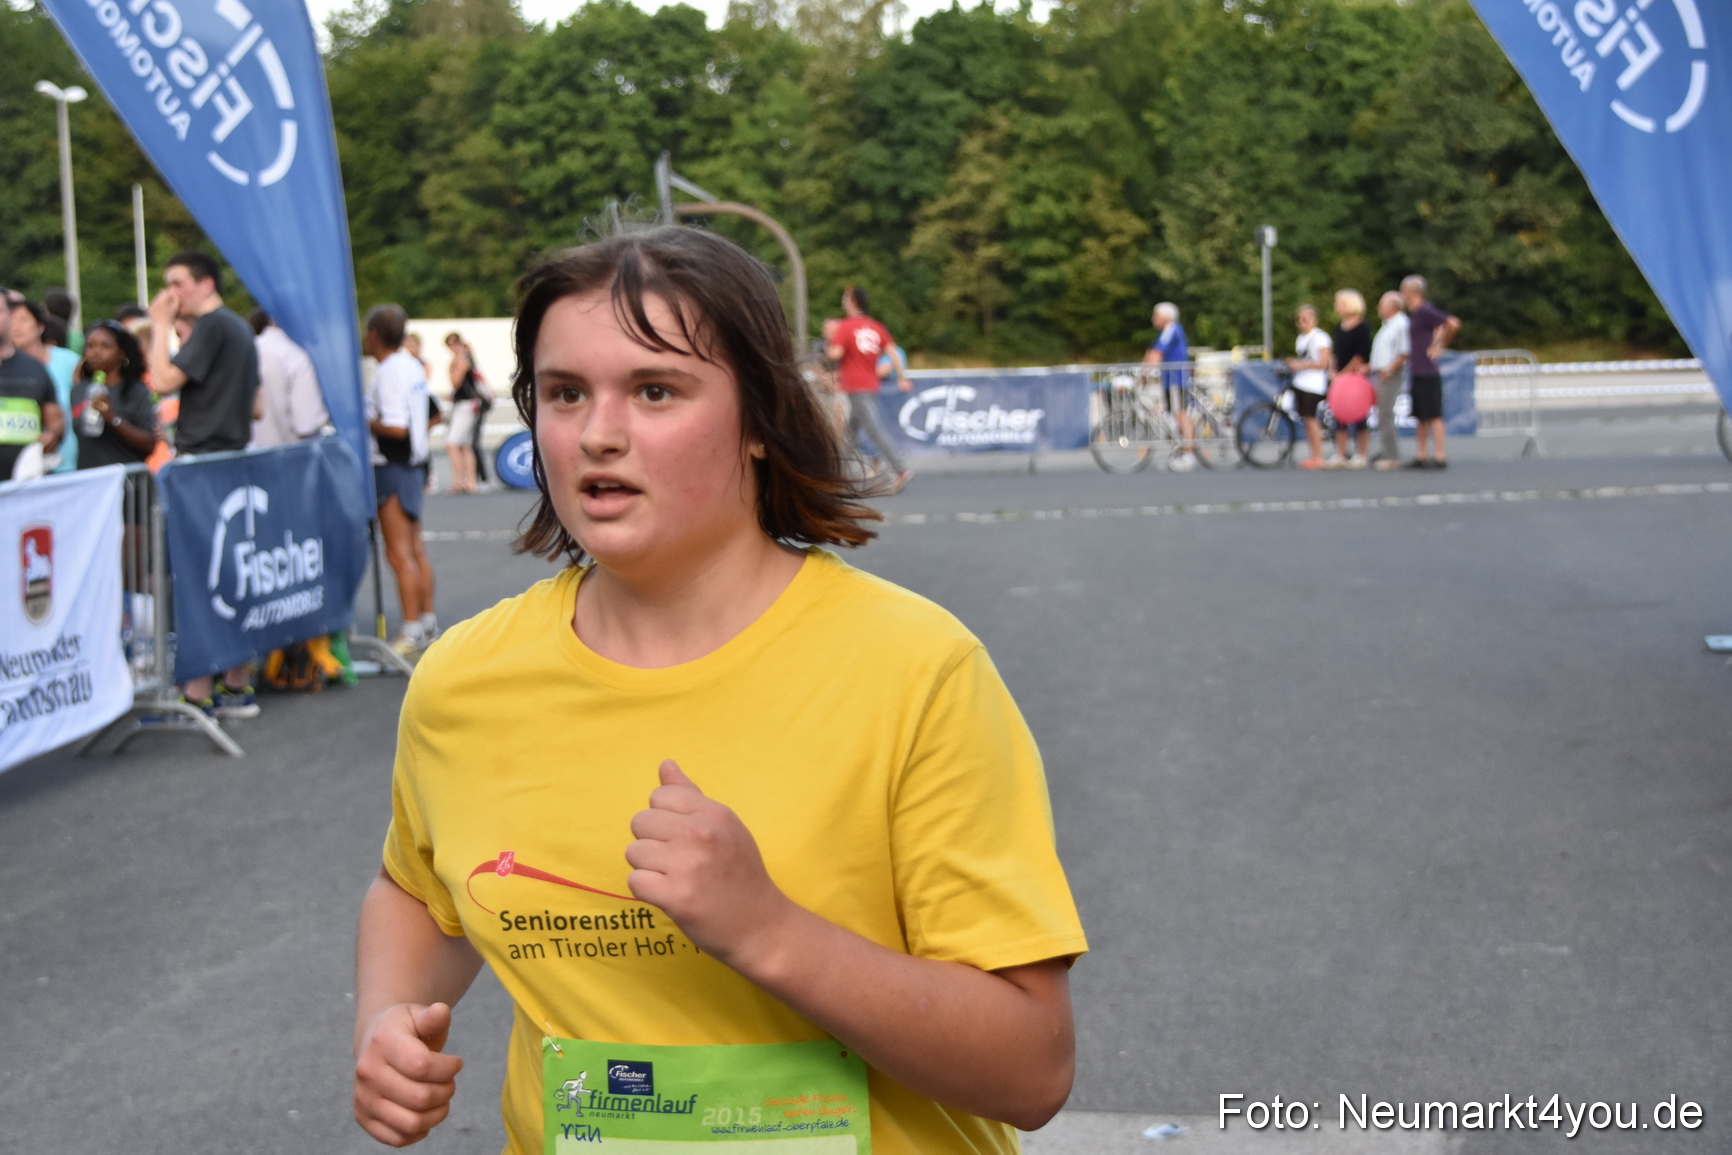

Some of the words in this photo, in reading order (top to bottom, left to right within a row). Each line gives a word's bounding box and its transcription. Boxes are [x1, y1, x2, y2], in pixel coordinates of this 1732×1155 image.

[925, 404, 1045, 433] Fischer
[499, 907, 656, 932] Seniorenstift
[508, 940, 545, 960] am
[549, 936, 627, 959] Tiroler
[634, 934, 676, 957] Hof
[615, 1070, 646, 1078] Fischer
[589, 1089, 698, 1114] firmenlauf
[589, 1111, 636, 1120] neumarkt
[701, 1106, 762, 1126] 2015
